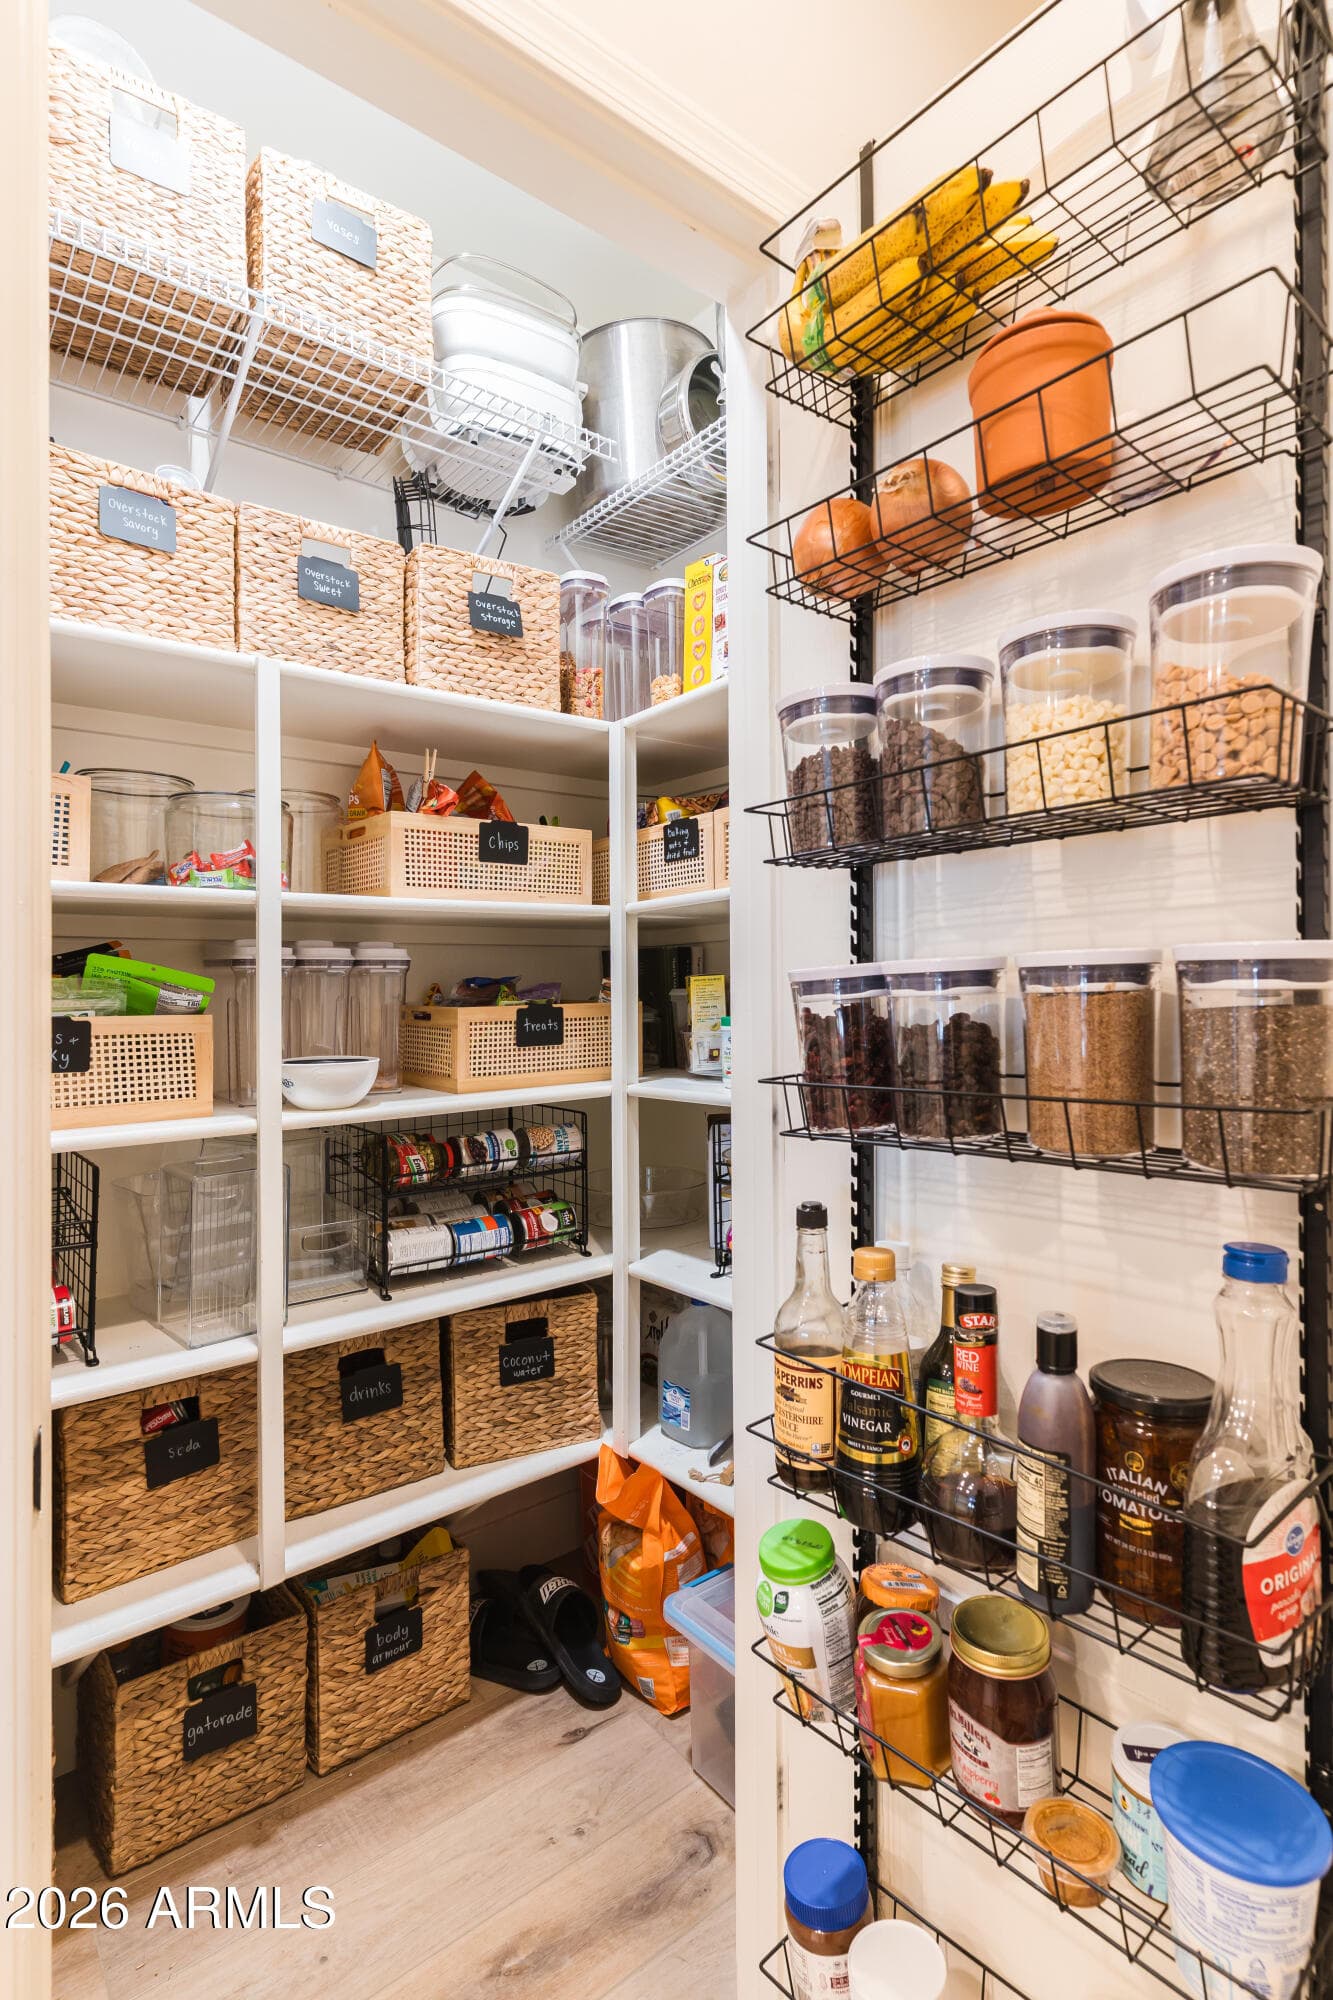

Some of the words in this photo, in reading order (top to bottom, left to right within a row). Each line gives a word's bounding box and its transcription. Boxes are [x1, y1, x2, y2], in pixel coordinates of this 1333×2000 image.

[108, 497, 168, 528] Overstock
[122, 516, 159, 541] Savory
[480, 612, 516, 630] storage
[524, 1018, 559, 1033] treats
[963, 1315, 997, 1328] STAR
[956, 1347, 980, 1363] RED
[956, 1359, 980, 1373] WINE
[513, 1365, 544, 1377] water
[780, 1371, 824, 1390] PERRINS
[841, 1363, 901, 1388] OMPEIAN
[350, 1381, 391, 1402] drinks
[842, 1412, 892, 1434] VINEGAR
[168, 1438, 201, 1460] soda
[1106, 1467, 1169, 1497] ITALIAN
[1260, 1546, 1318, 1596] ORIGINAL
[376, 1624, 410, 1648] body
[372, 1639, 413, 1665] armour
[187, 1705, 253, 1747] gatorade
